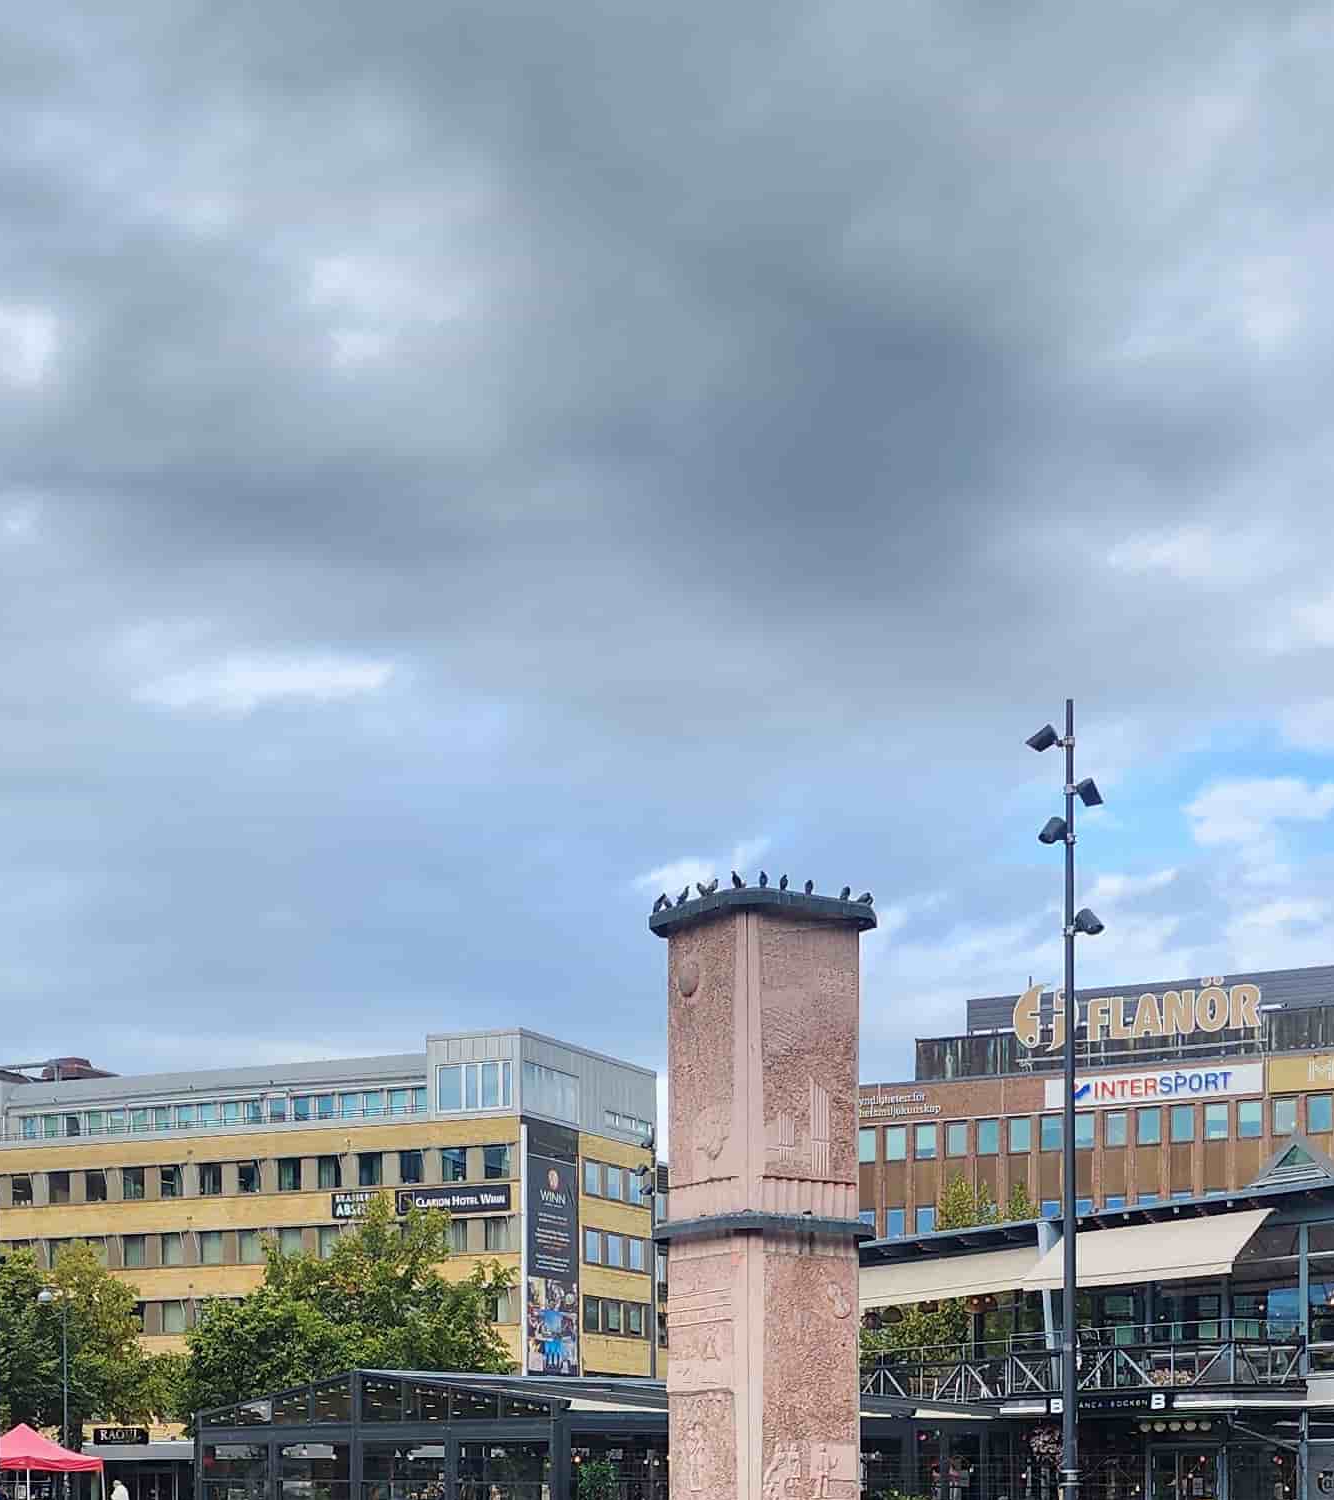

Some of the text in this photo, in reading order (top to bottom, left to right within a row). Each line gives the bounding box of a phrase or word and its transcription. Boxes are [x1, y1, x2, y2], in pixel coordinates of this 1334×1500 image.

[1087, 976, 1263, 1041] FLANÖR
[1093, 1071, 1233, 1099] INTERSPORT
[540, 1189, 566, 1204] WINN
[1150, 1393, 1166, 1410] B
